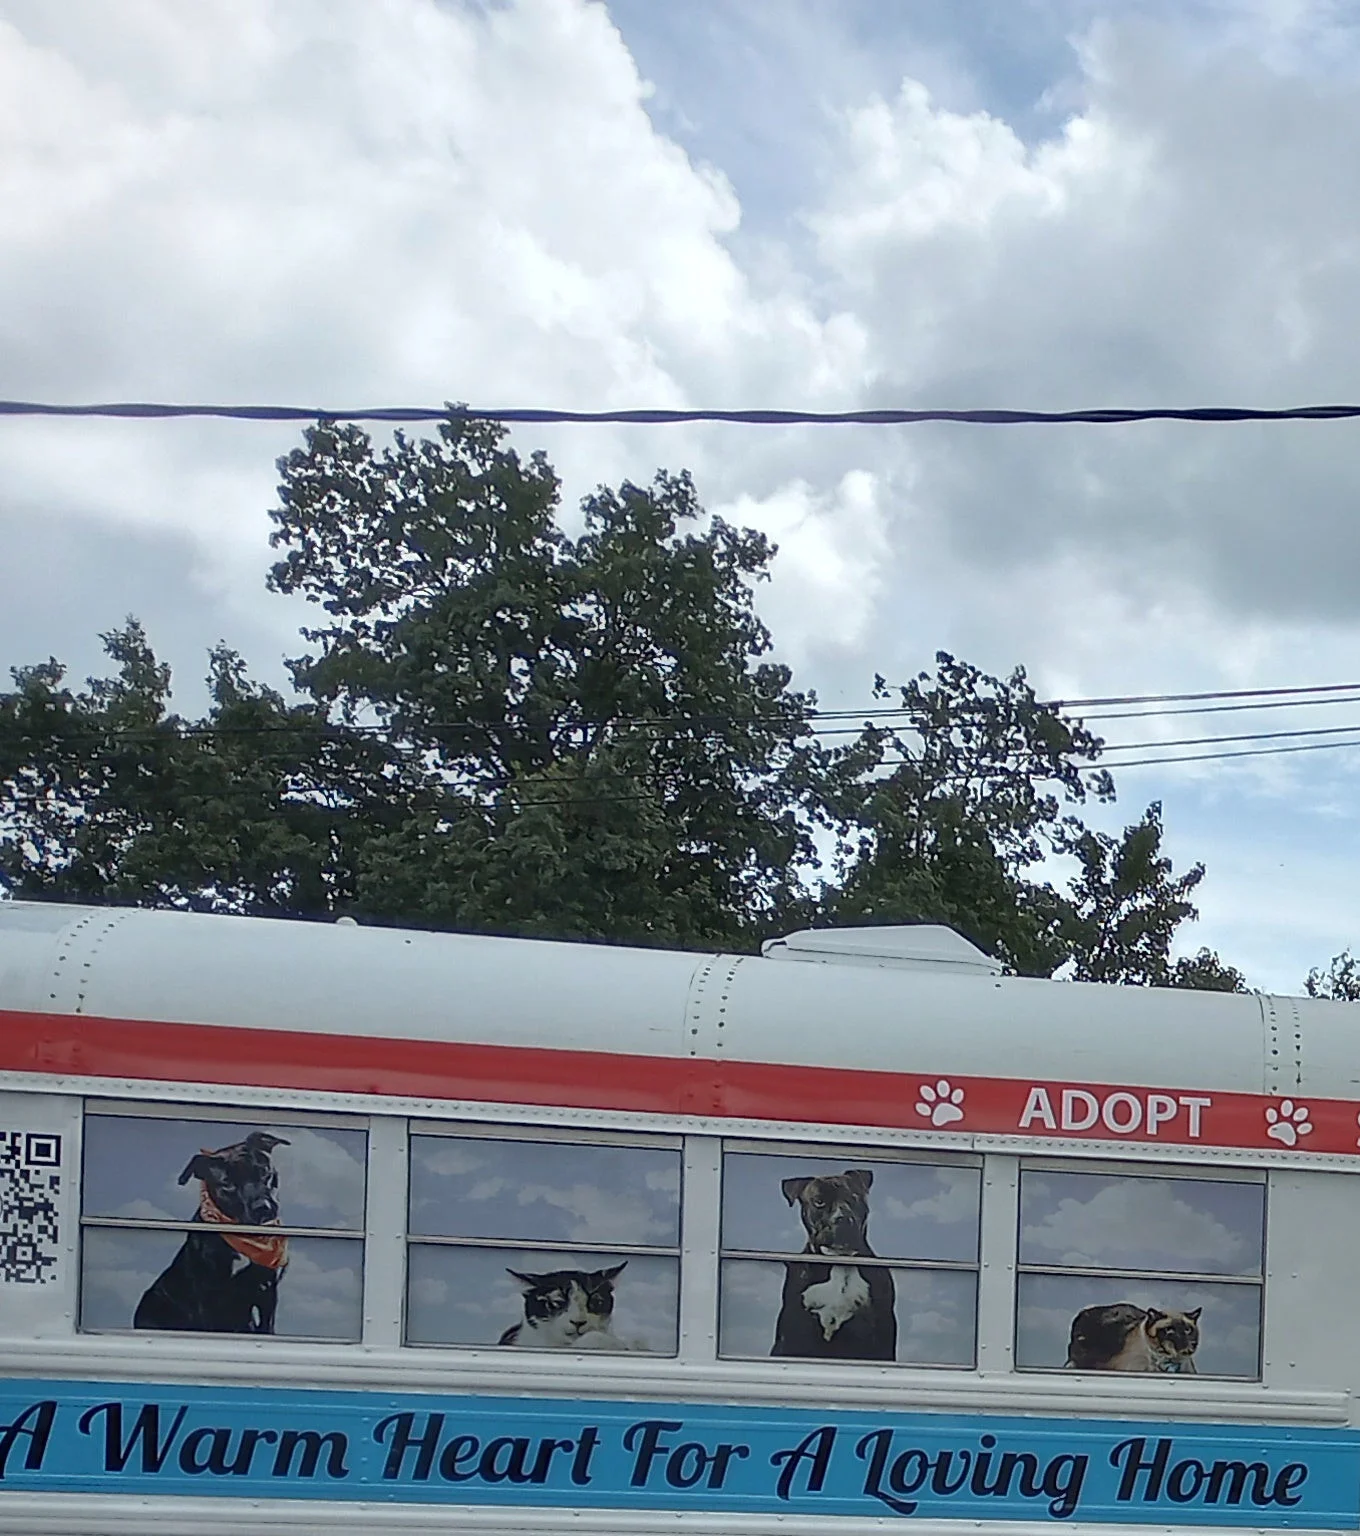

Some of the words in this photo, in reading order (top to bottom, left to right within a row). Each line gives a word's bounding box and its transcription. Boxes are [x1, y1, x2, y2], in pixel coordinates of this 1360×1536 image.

[1018, 1086, 1212, 1139] ADOPT
[0, 1400, 58, 1480] A
[78, 1402, 350, 1479] Warm
[372, 1412, 602, 1486] Heart
[622, 1420, 750, 1489] For
[769, 1426, 838, 1501] A
[855, 1428, 1089, 1519] Loving
[1109, 1437, 1308, 1507] Home
